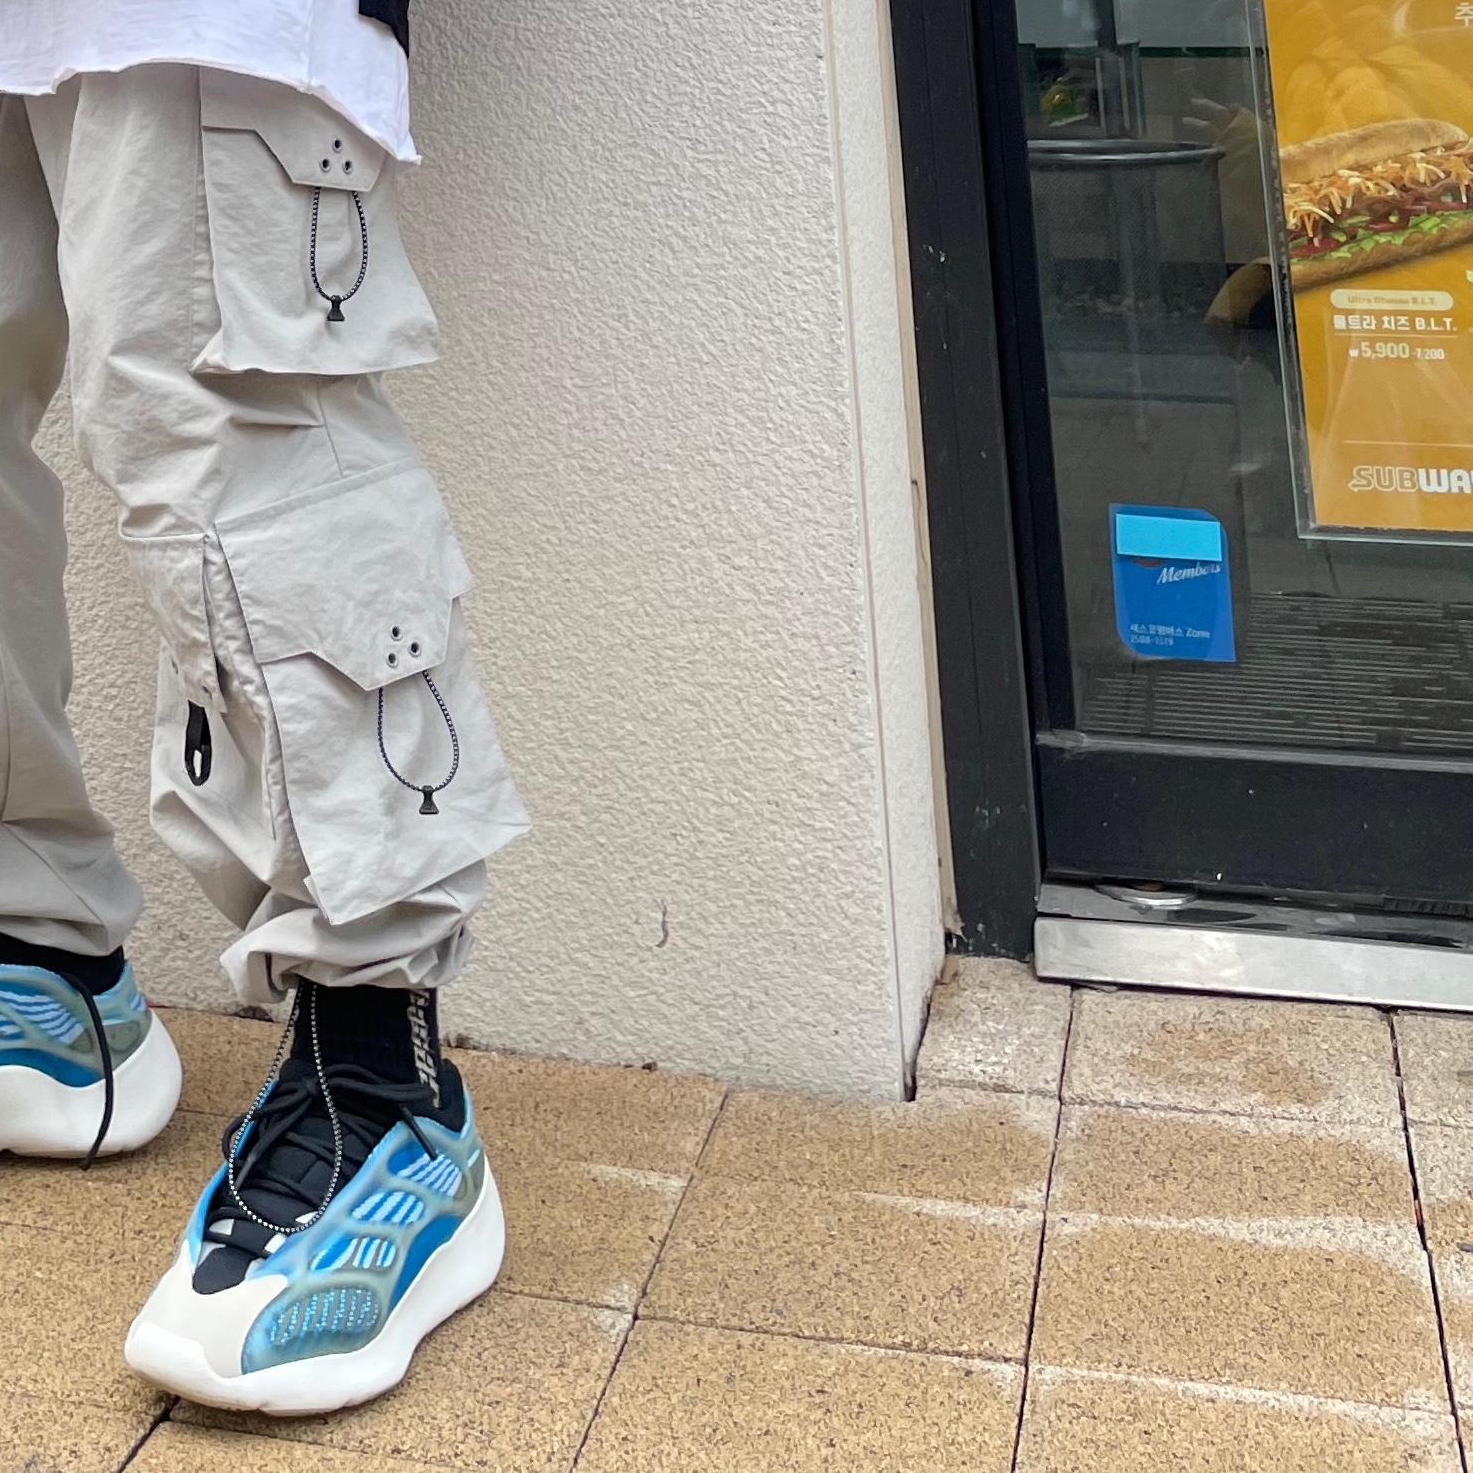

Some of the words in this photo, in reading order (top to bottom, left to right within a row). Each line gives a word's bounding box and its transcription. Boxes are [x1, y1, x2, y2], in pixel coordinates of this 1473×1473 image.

[1381, 315, 1411, 331] 치즈
[1415, 317, 1458, 332] B.L.T.
[1347, 464, 1473, 494] SUBWA
[1156, 561, 1221, 585] Members
